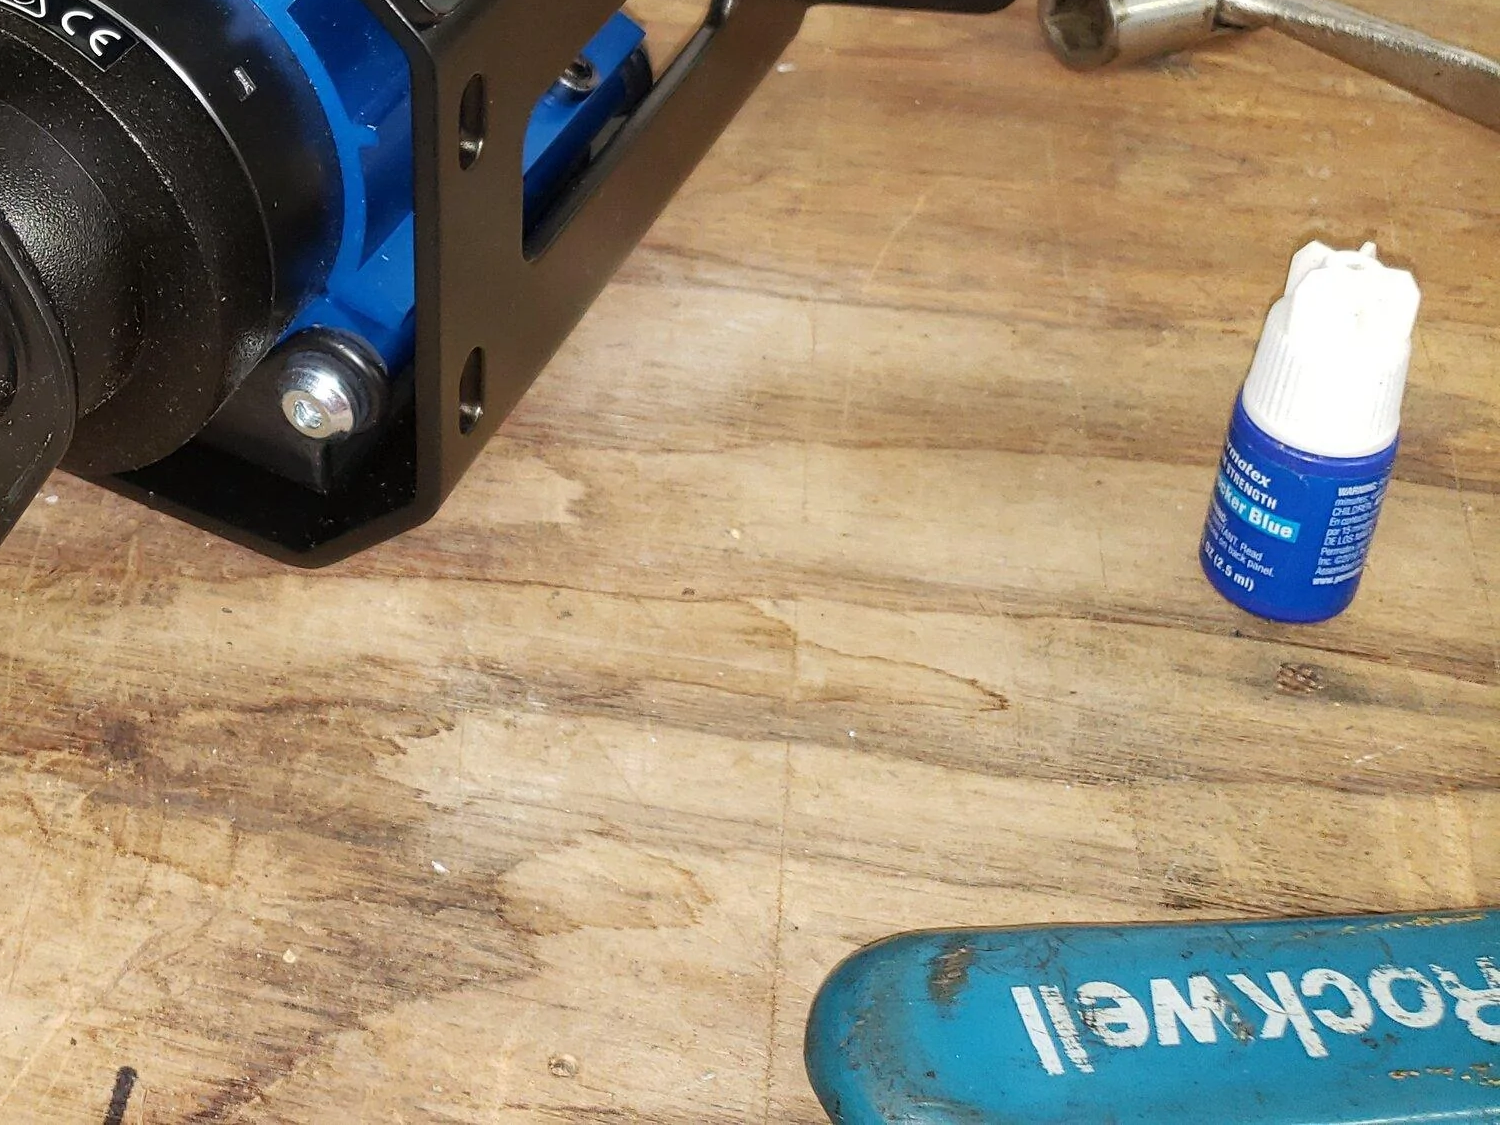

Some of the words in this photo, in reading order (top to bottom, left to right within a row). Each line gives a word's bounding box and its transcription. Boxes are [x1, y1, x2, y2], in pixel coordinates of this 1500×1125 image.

[1225, 463, 1278, 510] STRENGTH
[1249, 506, 1294, 539] Blue
[1234, 572, 1255, 592] ml)
[1010, 955, 1500, 1076] Rockwell
